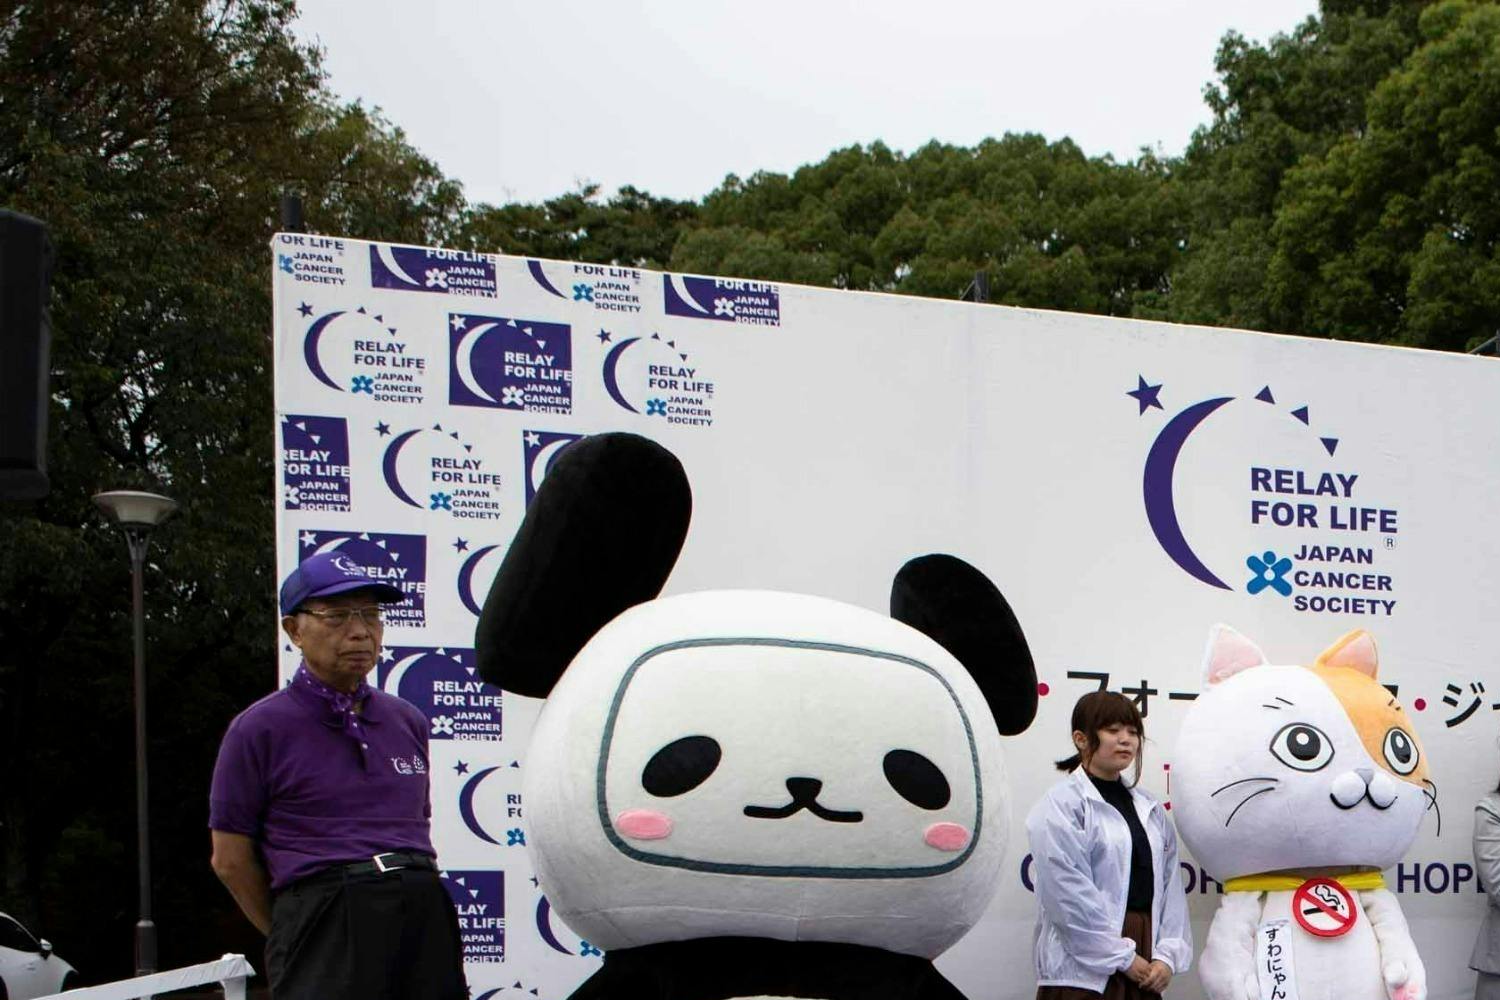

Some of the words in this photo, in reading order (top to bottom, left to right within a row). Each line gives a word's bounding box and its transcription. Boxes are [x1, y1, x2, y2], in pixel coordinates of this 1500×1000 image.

[310, 238, 344, 250] LIFE
[294, 252, 332, 262] JAPAN
[426, 250, 458, 261] FOR
[463, 252, 496, 264] LIFE
[294, 263, 343, 275] CANCER
[448, 266, 485, 277] JAPAN
[574, 265, 605, 277] FOR
[609, 267, 641, 279] LIFE
[295, 274, 346, 285] SOCIETY
[448, 277, 495, 289] CANCER
[594, 282, 630, 292] JAPAN
[715, 279, 746, 291] FOR
[749, 281, 779, 293] LIFE
[449, 288, 498, 299] SOCIETY
[594, 292, 640, 303] CANCER
[734, 296, 769, 306] JAPAN
[594, 302, 641, 313] SOCIETY
[734, 306, 778, 317] CANCER
[735, 315, 781, 327] SOCIETY
[354, 340, 406, 354] RELAY
[354, 354, 386, 367] FOR
[392, 357, 425, 369] LIFE
[504, 352, 554, 366] RELAY
[374, 372, 413, 382] JAPAN
[504, 365, 536, 378] FOR
[541, 368, 573, 381] LIFE
[649, 366, 696, 379] RELAY
[374, 383, 422, 393] CANCER
[524, 383, 561, 394] JAPAN
[649, 378, 679, 390] FOR
[683, 381, 714, 394] LIFE
[374, 394, 424, 404] SOCIETY
[524, 394, 571, 405] CANCER
[667, 396, 703, 406] JAPAN
[524, 404, 572, 416] SOCIETY
[667, 406, 711, 417] CANCER
[667, 416, 713, 427] SOCIETY
[431, 457, 482, 470] RELAY
[283, 463, 311, 476] FOR
[316, 465, 350, 478] LIFE
[432, 471, 463, 484] FOR
[468, 474, 501, 486] LIFE
[1251, 467, 1358, 498] RELAY
[299, 481, 339, 491] JAPAN
[300, 492, 349, 502] CANCER
[452, 488, 490, 499] JAPAN
[300, 502, 351, 512] SOCIETY
[452, 499, 499, 510] CANCER
[452, 510, 501, 520] SOCIETY
[1251, 500, 1319, 528] FOR
[1330, 506, 1398, 533] LIFE
[1294, 545, 1373, 564] JAPAN
[1294, 571, 1392, 591] CANCER
[1294, 596, 1396, 616] SOCIETY
[382, 620, 427, 628] OCIETY
[433, 681, 484, 693] RELAY
[433, 695, 466, 706] FOR
[470, 696, 503, 707] LIFE
[453, 712, 492, 721] JAPAN
[453, 723, 500, 732] CANCER
[453, 733, 503, 741] SOCIETY
[473, 918, 506, 929] LIFE
[463, 945, 503, 953] ANCER
[463, 955, 505, 964] OCIETY
[1266, 928, 1286, 1000] すわにゃん
